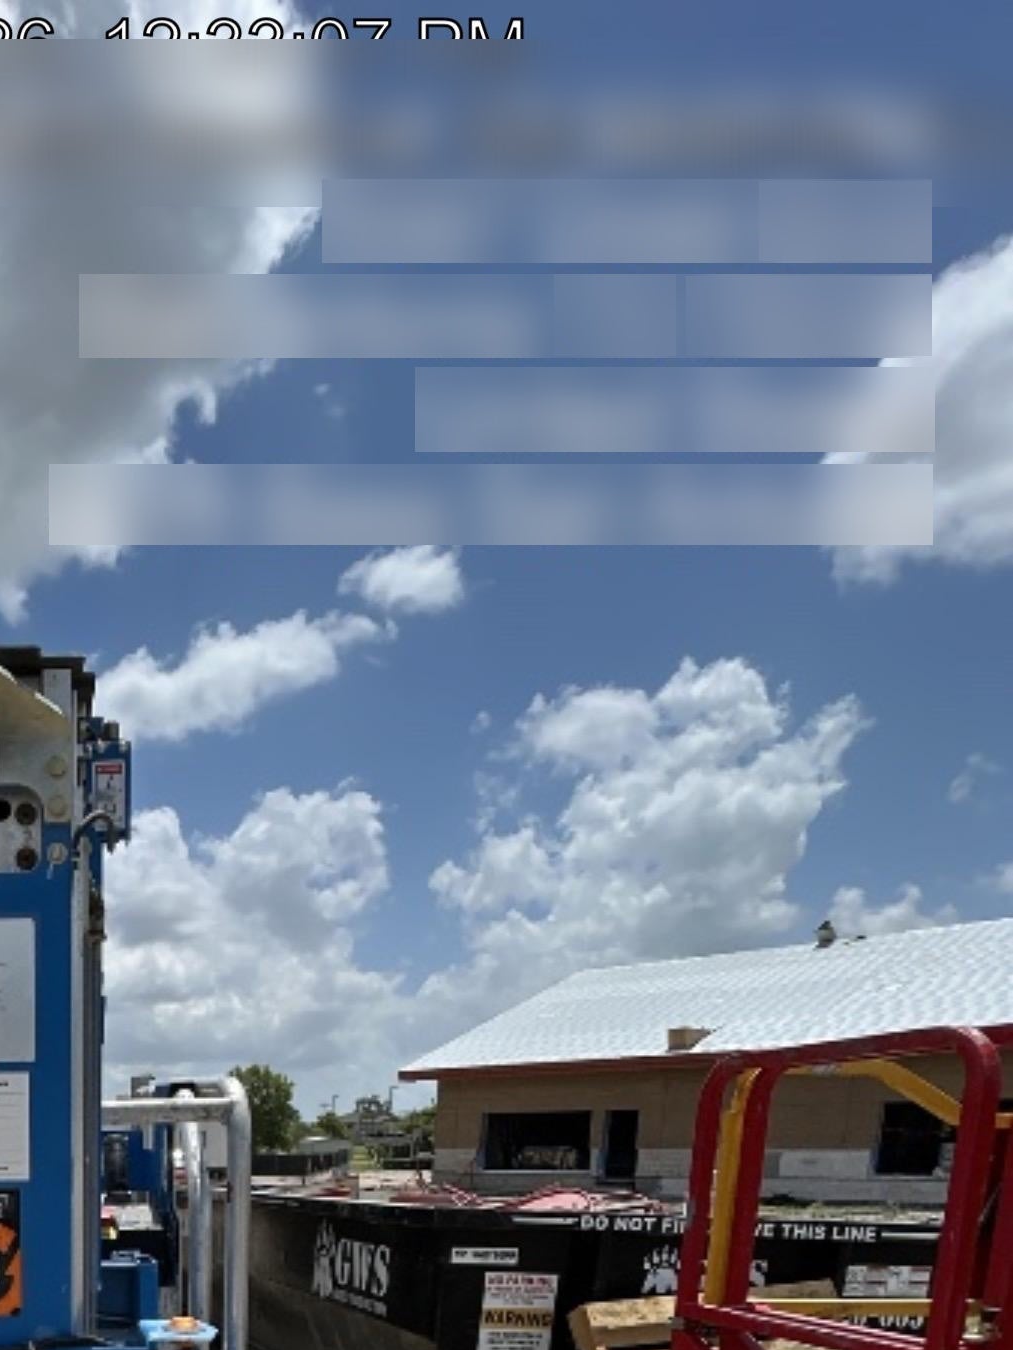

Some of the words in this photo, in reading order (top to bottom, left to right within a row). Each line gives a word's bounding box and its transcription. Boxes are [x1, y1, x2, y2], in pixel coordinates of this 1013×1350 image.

[580, 1216, 609, 1230] DO
[614, 1217, 655, 1231] NOT
[782, 1224, 827, 1241] THIS
[832, 1227, 876, 1242] LINE
